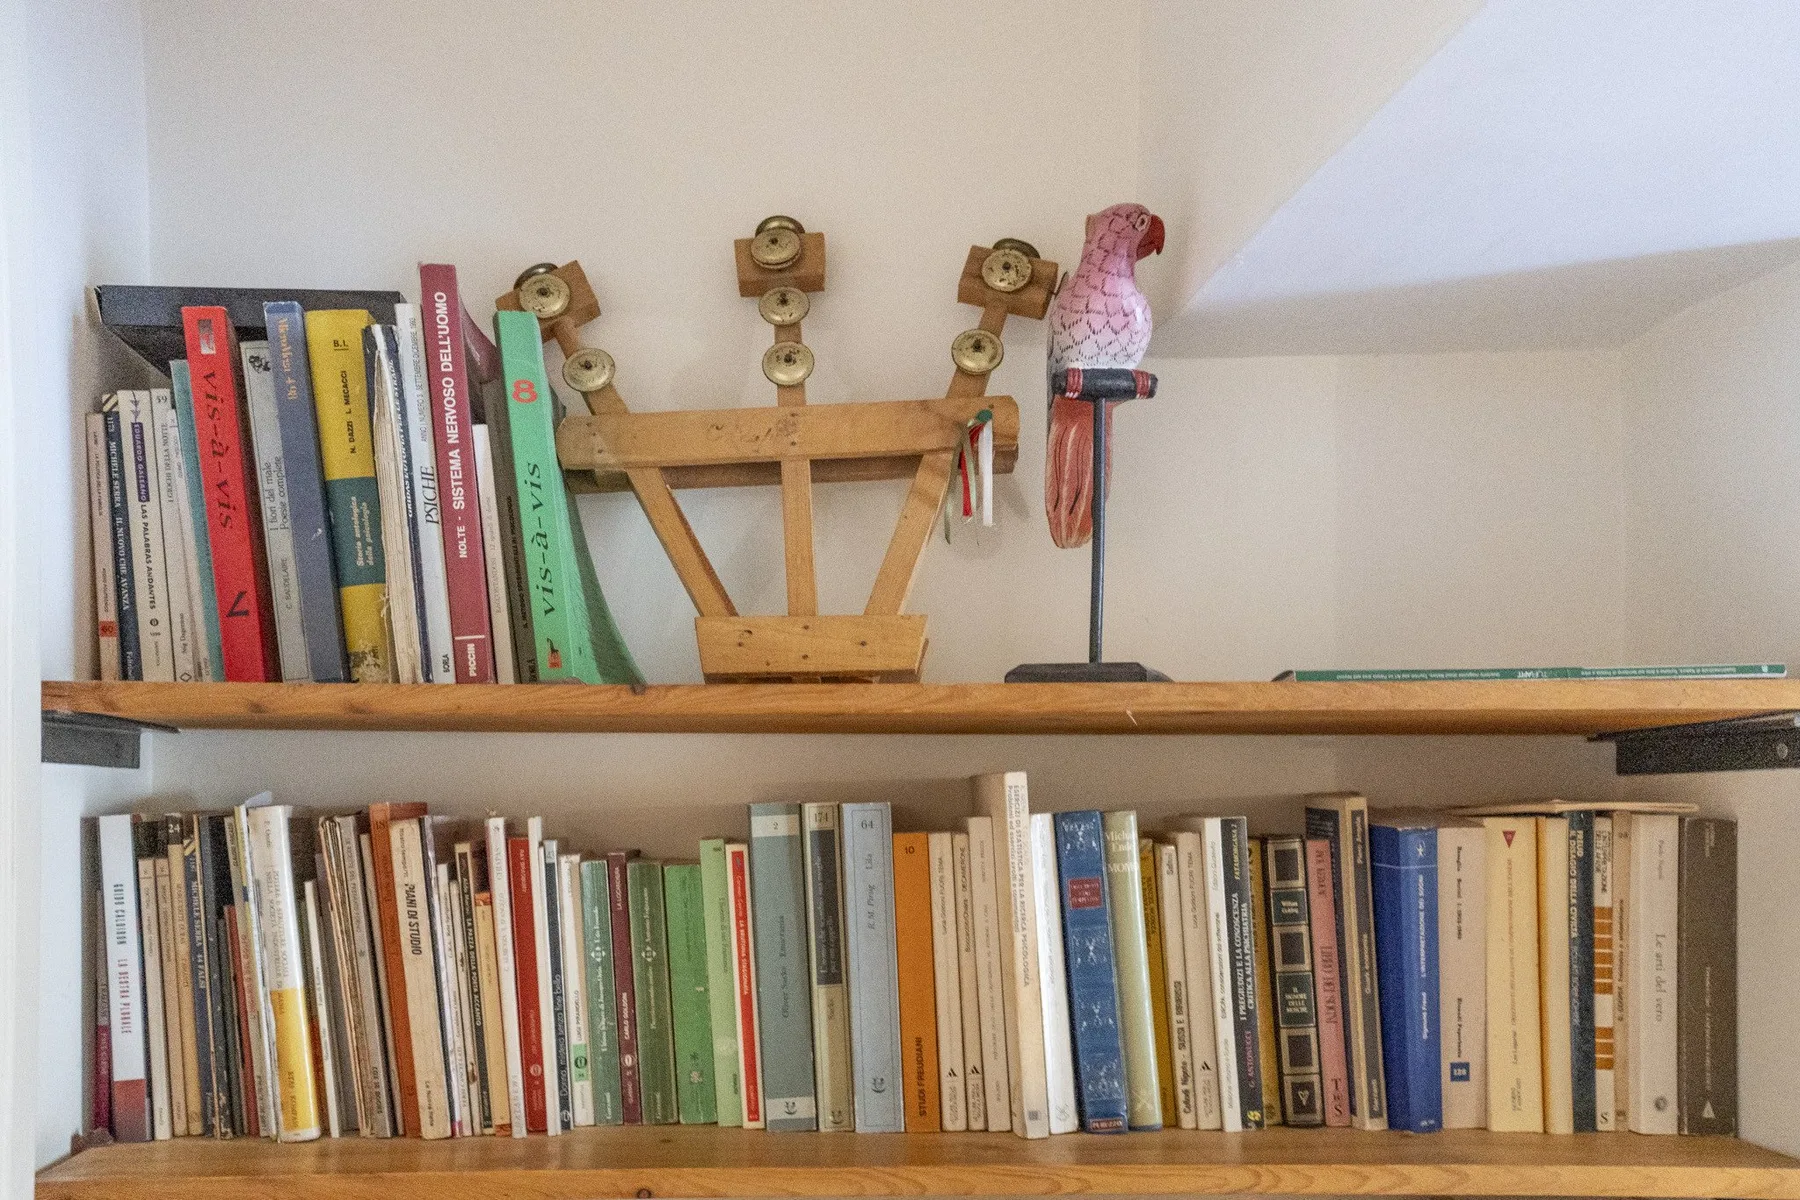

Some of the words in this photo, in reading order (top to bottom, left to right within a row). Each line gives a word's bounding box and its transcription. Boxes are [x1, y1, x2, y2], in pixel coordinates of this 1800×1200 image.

[434, 291, 453, 372] DELL'UOMO
[340, 370, 351, 405] MECACCI
[512, 378, 539, 405] 8
[442, 377, 459, 444] NERVOSO
[134, 423, 143, 461] EDUARDO
[160, 423, 169, 446] NOTTE
[347, 421, 356, 443] DAZZI
[109, 441, 118, 479] MICHELE
[163, 448, 171, 470] DELLA
[202, 370, 236, 530] vis-à-vis
[137, 464, 147, 500] GALEANO
[263, 462, 274, 485] male
[274, 456, 288, 498] complete
[449, 449, 465, 510] SISTEMA
[112, 480, 121, 508] SERRA
[265, 489, 275, 503] del
[419, 466, 440, 525] PSICHE
[116, 517, 122, 526] IL
[140, 505, 148, 518] LAS
[278, 502, 290, 530] Poesie
[350, 497, 361, 538] antologica
[361, 502, 373, 543] psicologia
[116, 528, 125, 556] NUOVO
[143, 521, 153, 563] PALABRAS
[457, 525, 468, 558] NOLTE
[522, 462, 557, 617] vis-à-vis
[356, 542, 365, 567] Storia
[121, 576, 130, 611] AVANZA
[146, 566, 156, 609] ANDANTES
[441, 654, 450, 673] BORLA
[466, 643, 477, 677] PICCIN
[1013, 785, 1021, 818] ESERCIZI
[168, 823, 181, 833] 24
[773, 822, 780, 831] 2
[860, 819, 874, 830] 64
[1009, 820, 1015, 829] ed
[1015, 819, 1021, 828] DI
[1354, 816, 1363, 842] Angela
[1570, 830, 1576, 839] IL
[865, 853, 874, 870] Lila
[905, 846, 915, 855] 10
[1015, 829, 1023, 871] STATISTICA
[1231, 829, 1241, 881] FATAMORGANA
[814, 856, 824, 881] moglie
[937, 857, 945, 873] TEMA
[959, 847, 967, 892] DECAMERONE
[614, 867, 622, 902] LOCANDIERA
[736, 875, 744, 897] Carmen
[938, 875, 946, 895] FUORI
[1188, 869, 1196, 889] FUORI
[1570, 878, 1578, 904] DELLA
[113, 884, 125, 905] GUIDO
[176, 884, 185, 922] MARGUERITE
[191, 881, 200, 918] MICHELE
[404, 883, 417, 908] PIANI
[866, 884, 876, 907] Pirsig
[1019, 889, 1025, 898] LA
[1189, 891, 1198, 913] Goldoni
[407, 910, 418, 920] DI
[466, 918, 473, 927] LA
[1011, 888, 1019, 932] commentati
[1019, 900, 1027, 931] RICERCA
[1231, 892, 1242, 947] CONOSCENZA
[1570, 906, 1579, 938] CIVILTÀ
[178, 924, 186, 944] DURAS
[194, 920, 202, 947] SERRA
[409, 921, 422, 955] STUDIO
[467, 928, 475, 949] PAZZA
[777, 915, 786, 958] Emicrania
[1240, 902, 1251, 954] PSICHIATRIA
[1654, 933, 1666, 948] Le
[739, 928, 748, 957] BRUTTINA
[1235, 948, 1243, 959] LA
[1362, 934, 1370, 970] economia
[1418, 911, 1427, 978] L'INTERPRETAZIONE
[117, 959, 128, 967] LA
[196, 954, 203, 964] 44
[1021, 934, 1030, 987] PSICOLOGICA
[1243, 955, 1253, 975] ALLA
[1655, 952, 1666, 971] arti
[119, 971, 131, 999] DESTRA
[197, 965, 206, 989] FALSI
[554, 974, 562, 994] bello
[741, 958, 750, 995] STAGIONATA
[780, 966, 788, 990] Sacks
[1655, 976, 1667, 993] del
[555, 996, 563, 1011] fine
[1237, 968, 1247, 1015] PREGIUDIZI
[1246, 977, 1255, 1010] CRITICA
[119, 1002, 132, 1034] PLURALE
[473, 995, 482, 1026] ACCANTO
[574, 990, 582, 1025] PIRANDELLO
[621, 993, 630, 1019] GOLDONI
[781, 992, 790, 1018] Oliver
[1655, 998, 1665, 1022] vero
[557, 1012, 565, 1036] senza
[623, 1020, 631, 1040] CARLO
[1176, 1026, 1187, 1050] SUSSI
[557, 1038, 566, 1066] mistero
[915, 1037, 926, 1087] FREUDIANI
[1245, 1030, 1255, 1078] ANTONUCCI
[425, 1081, 431, 1089] La
[1179, 1060, 1191, 1086] Nipote
[916, 1087, 927, 1117] STUDI
[1181, 1088, 1192, 1114] Collodi
